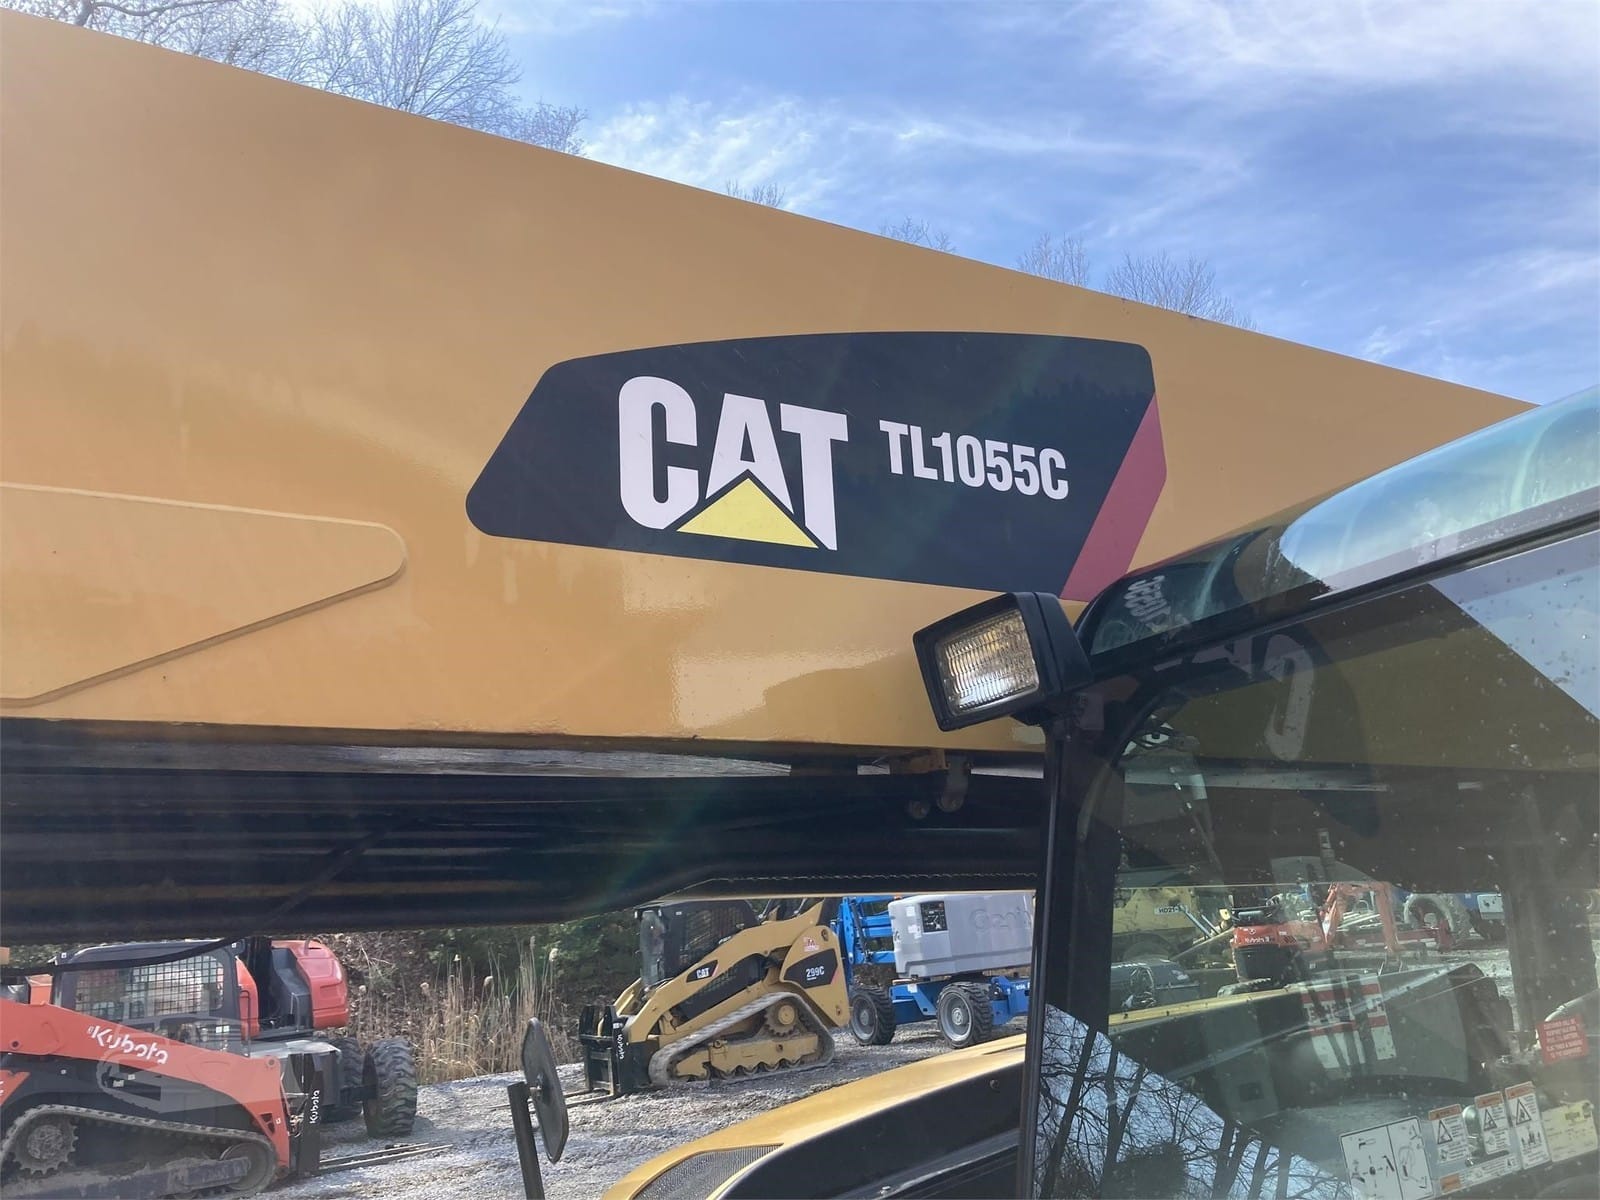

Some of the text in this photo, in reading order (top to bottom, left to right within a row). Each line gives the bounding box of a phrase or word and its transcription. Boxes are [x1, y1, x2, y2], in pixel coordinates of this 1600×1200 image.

[619, 376, 848, 551] CAT
[879, 420, 1069, 500] TL1055C
[696, 967, 709, 979] CAT
[806, 965, 825, 978] 299C
[93, 1025, 169, 1065] Kubota
[309, 1090, 320, 1124] Kubota
